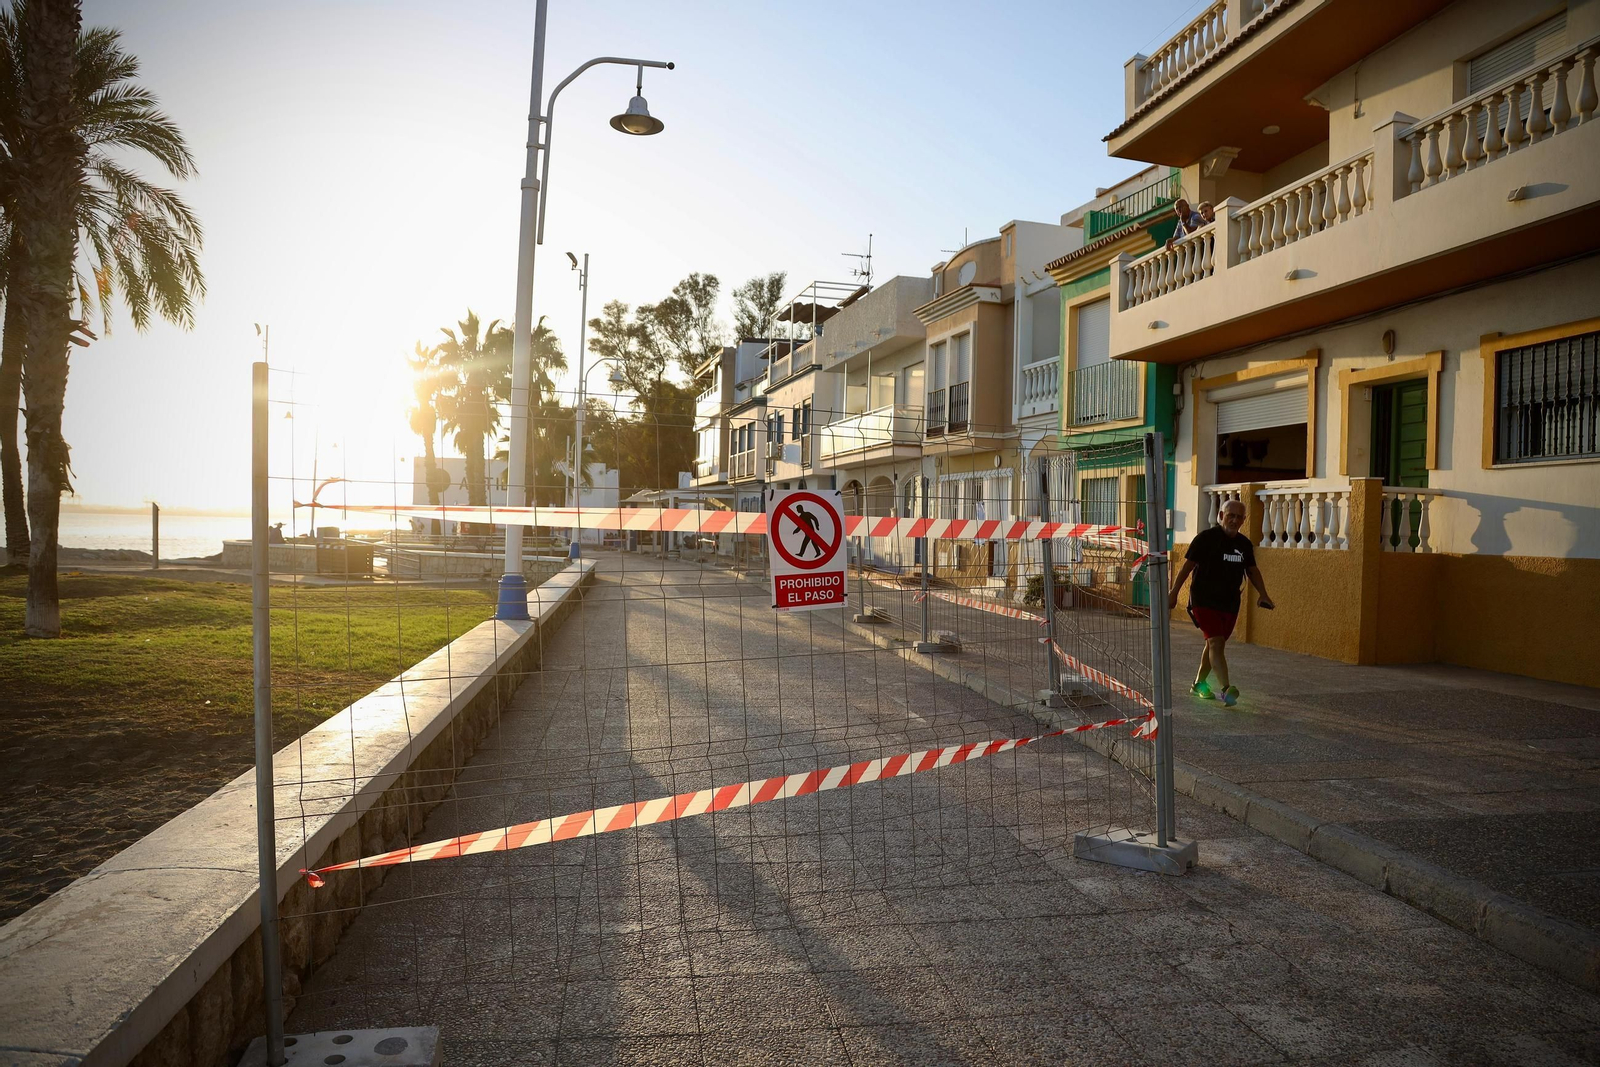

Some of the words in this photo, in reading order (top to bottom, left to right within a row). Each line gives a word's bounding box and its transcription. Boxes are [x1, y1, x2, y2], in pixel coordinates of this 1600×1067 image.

[1223, 553, 1242, 562] PUMA
[780, 576, 840, 589] PROHIBIDO
[788, 593, 802, 602] EL
[804, 590, 834, 601] PASO
